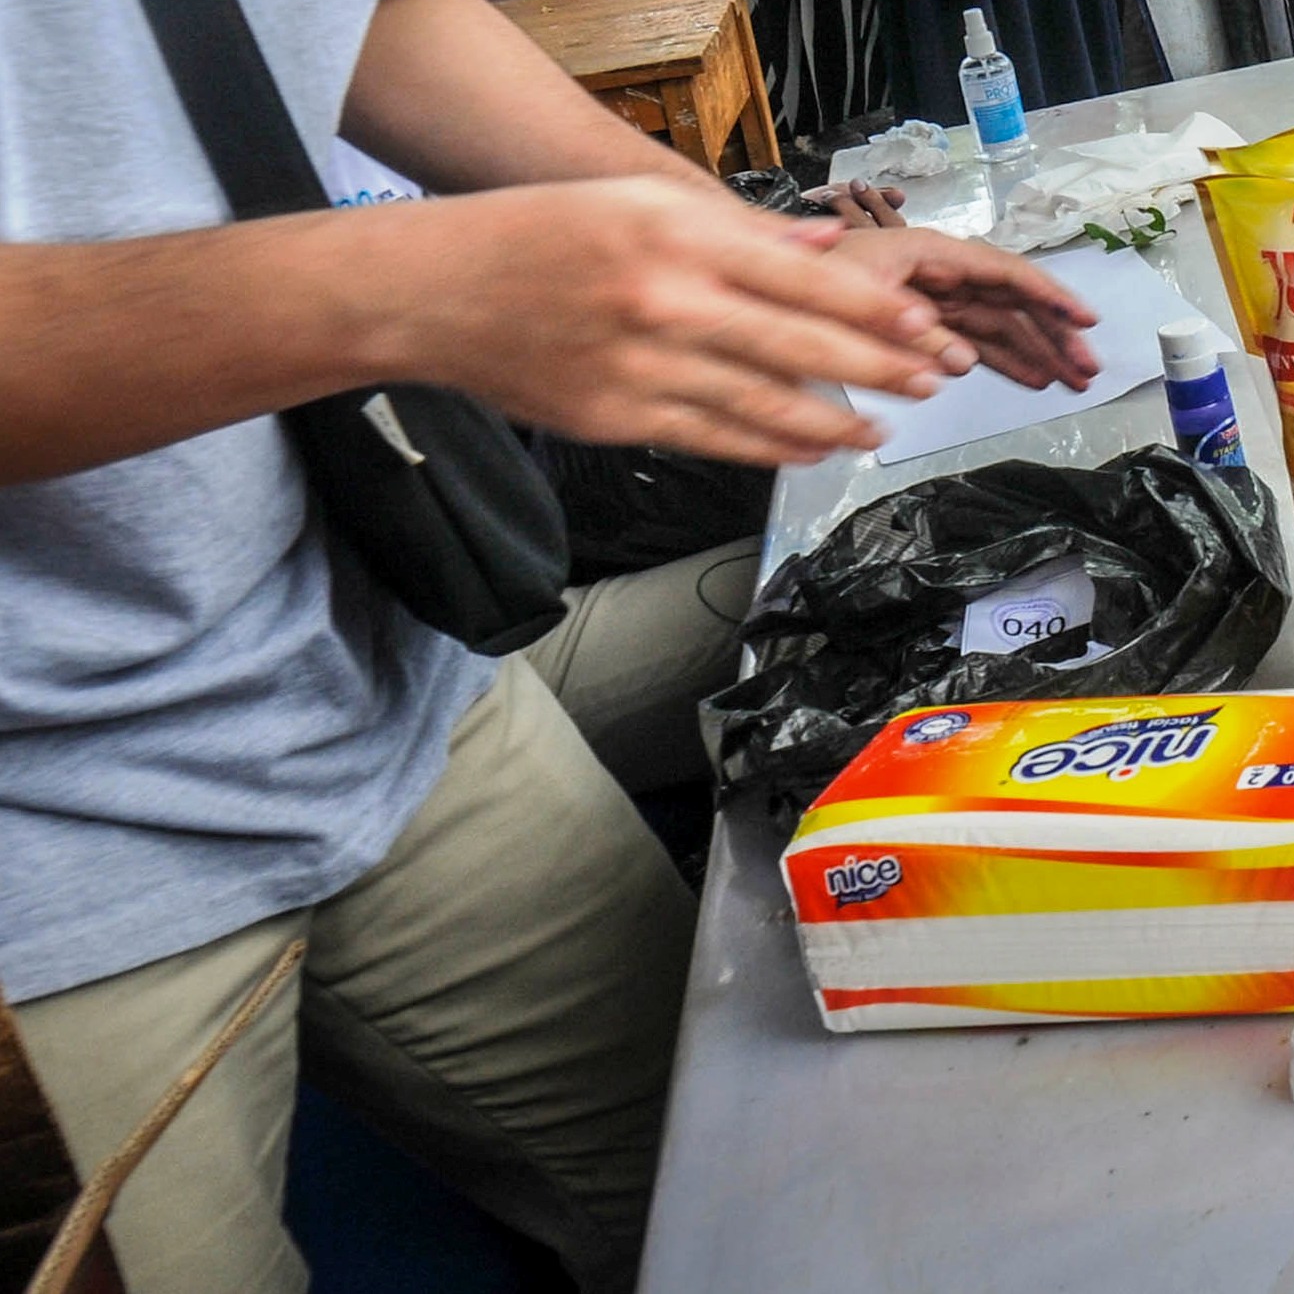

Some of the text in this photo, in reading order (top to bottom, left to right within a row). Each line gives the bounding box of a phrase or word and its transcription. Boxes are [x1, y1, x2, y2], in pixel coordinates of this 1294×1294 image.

[1003, 616, 1066, 639] 040
[1016, 724, 1214, 781] nice
[1247, 772, 1263, 786] 2
[826, 856, 899, 894] nice
